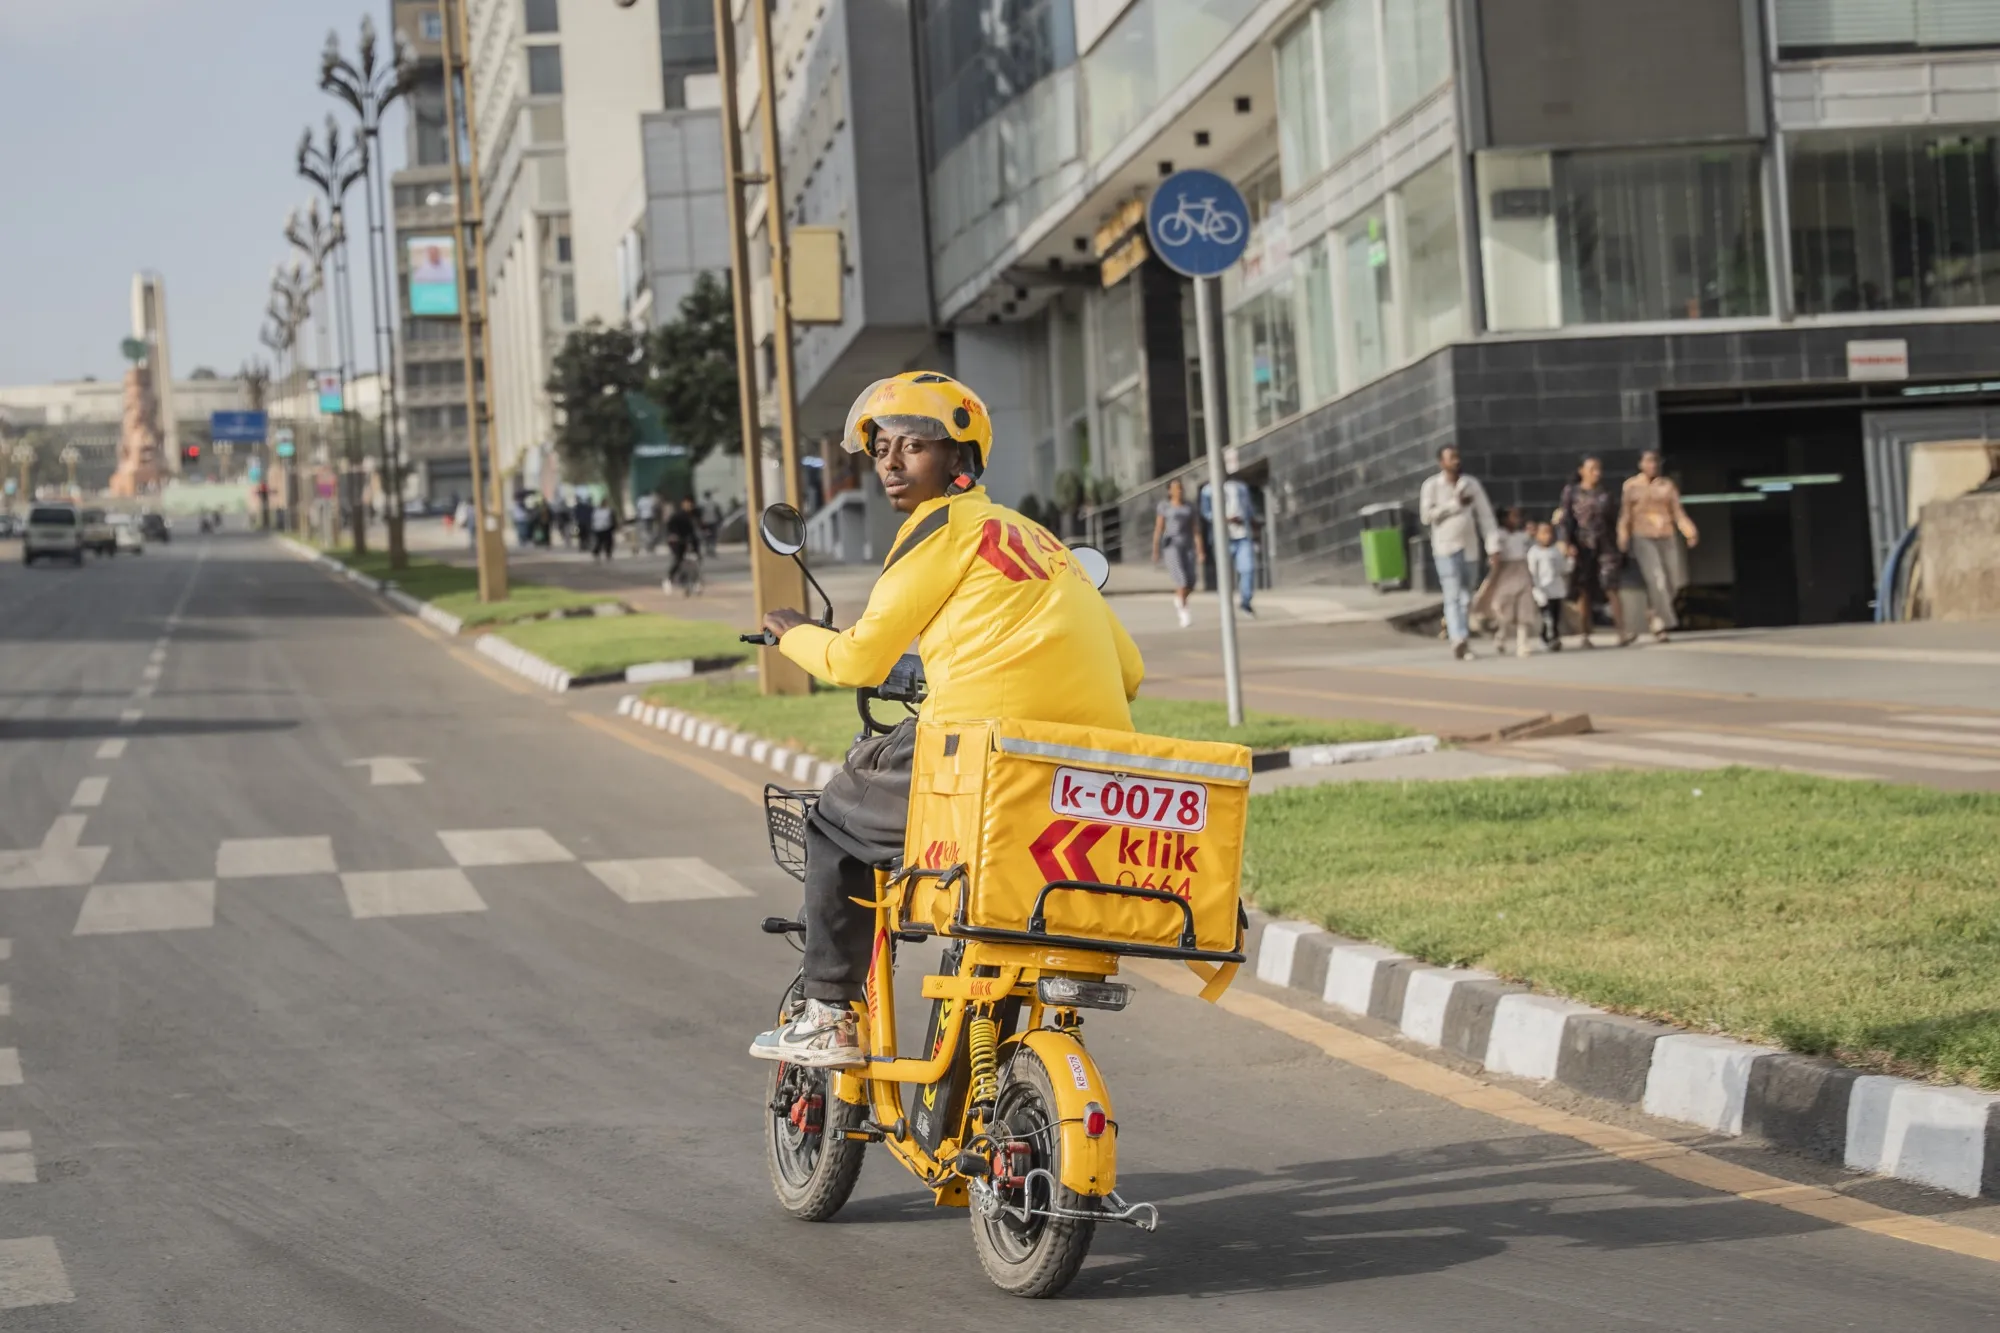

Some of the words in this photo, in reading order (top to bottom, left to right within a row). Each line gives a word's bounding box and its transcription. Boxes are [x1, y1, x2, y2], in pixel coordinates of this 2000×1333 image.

[1060, 774, 1200, 826] k-0078
[1118, 826, 1200, 873] klik
[970, 981, 985, 996] klik
[1069, 1056, 1086, 1087] KB-0078
